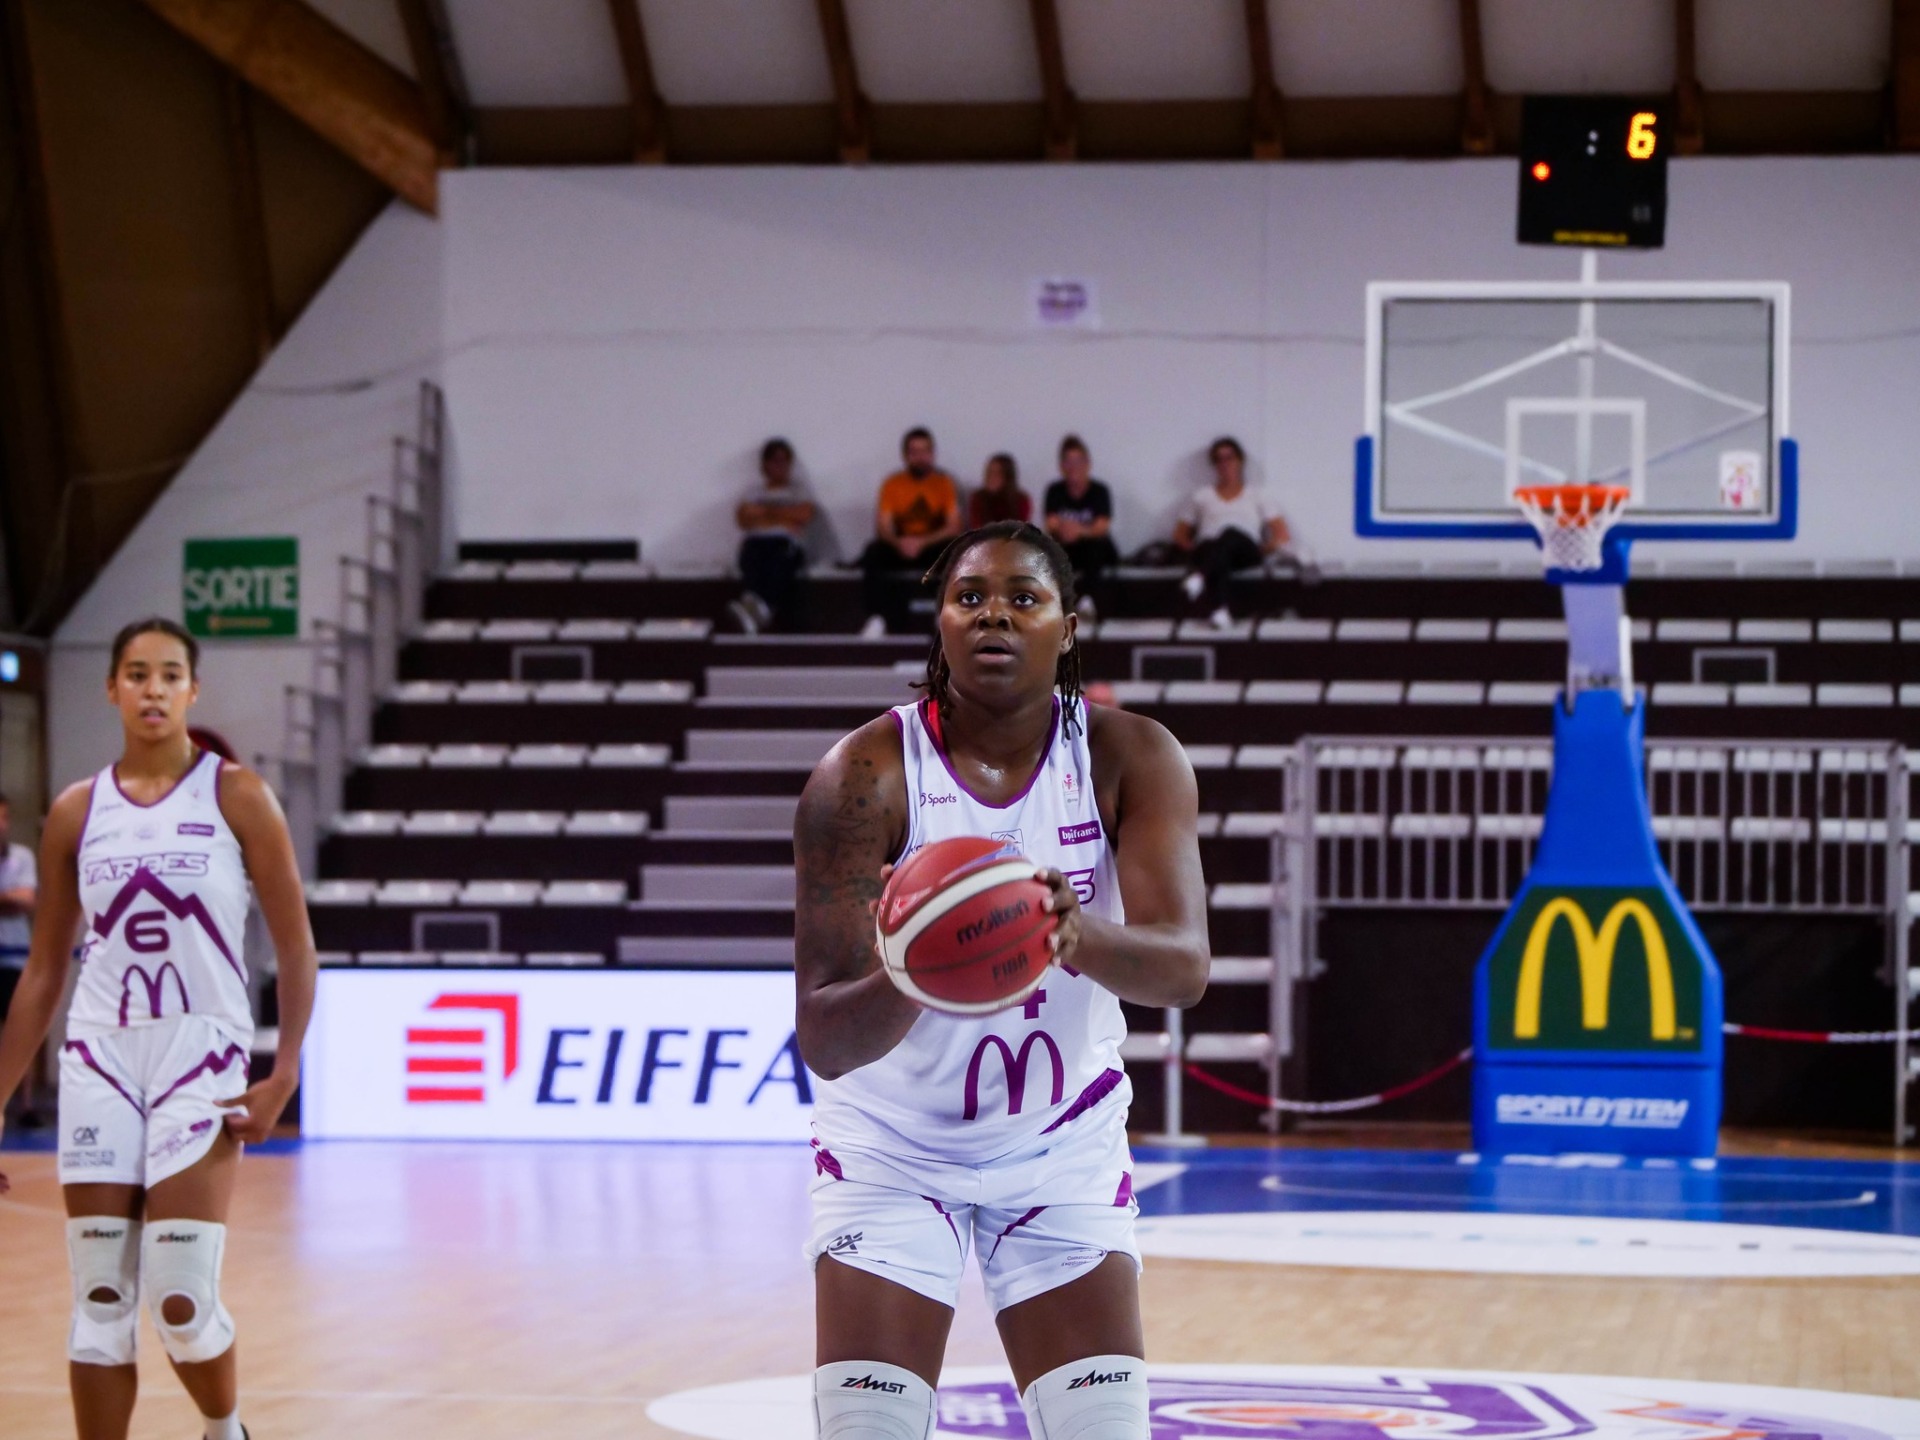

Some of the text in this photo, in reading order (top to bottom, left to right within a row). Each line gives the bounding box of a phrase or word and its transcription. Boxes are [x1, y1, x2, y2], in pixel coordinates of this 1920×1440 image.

[1628, 112, 1657, 159] 6
[184, 566, 298, 609] SORTIE
[928, 793, 957, 807] Sports
[85, 852, 210, 886] TARBES
[124, 910, 170, 953] 6
[955, 899, 1030, 945] molten
[992, 951, 1028, 981] FIBA
[840, 1374, 907, 1395] ZAMST
[1066, 1370, 1131, 1391] ZAMST
